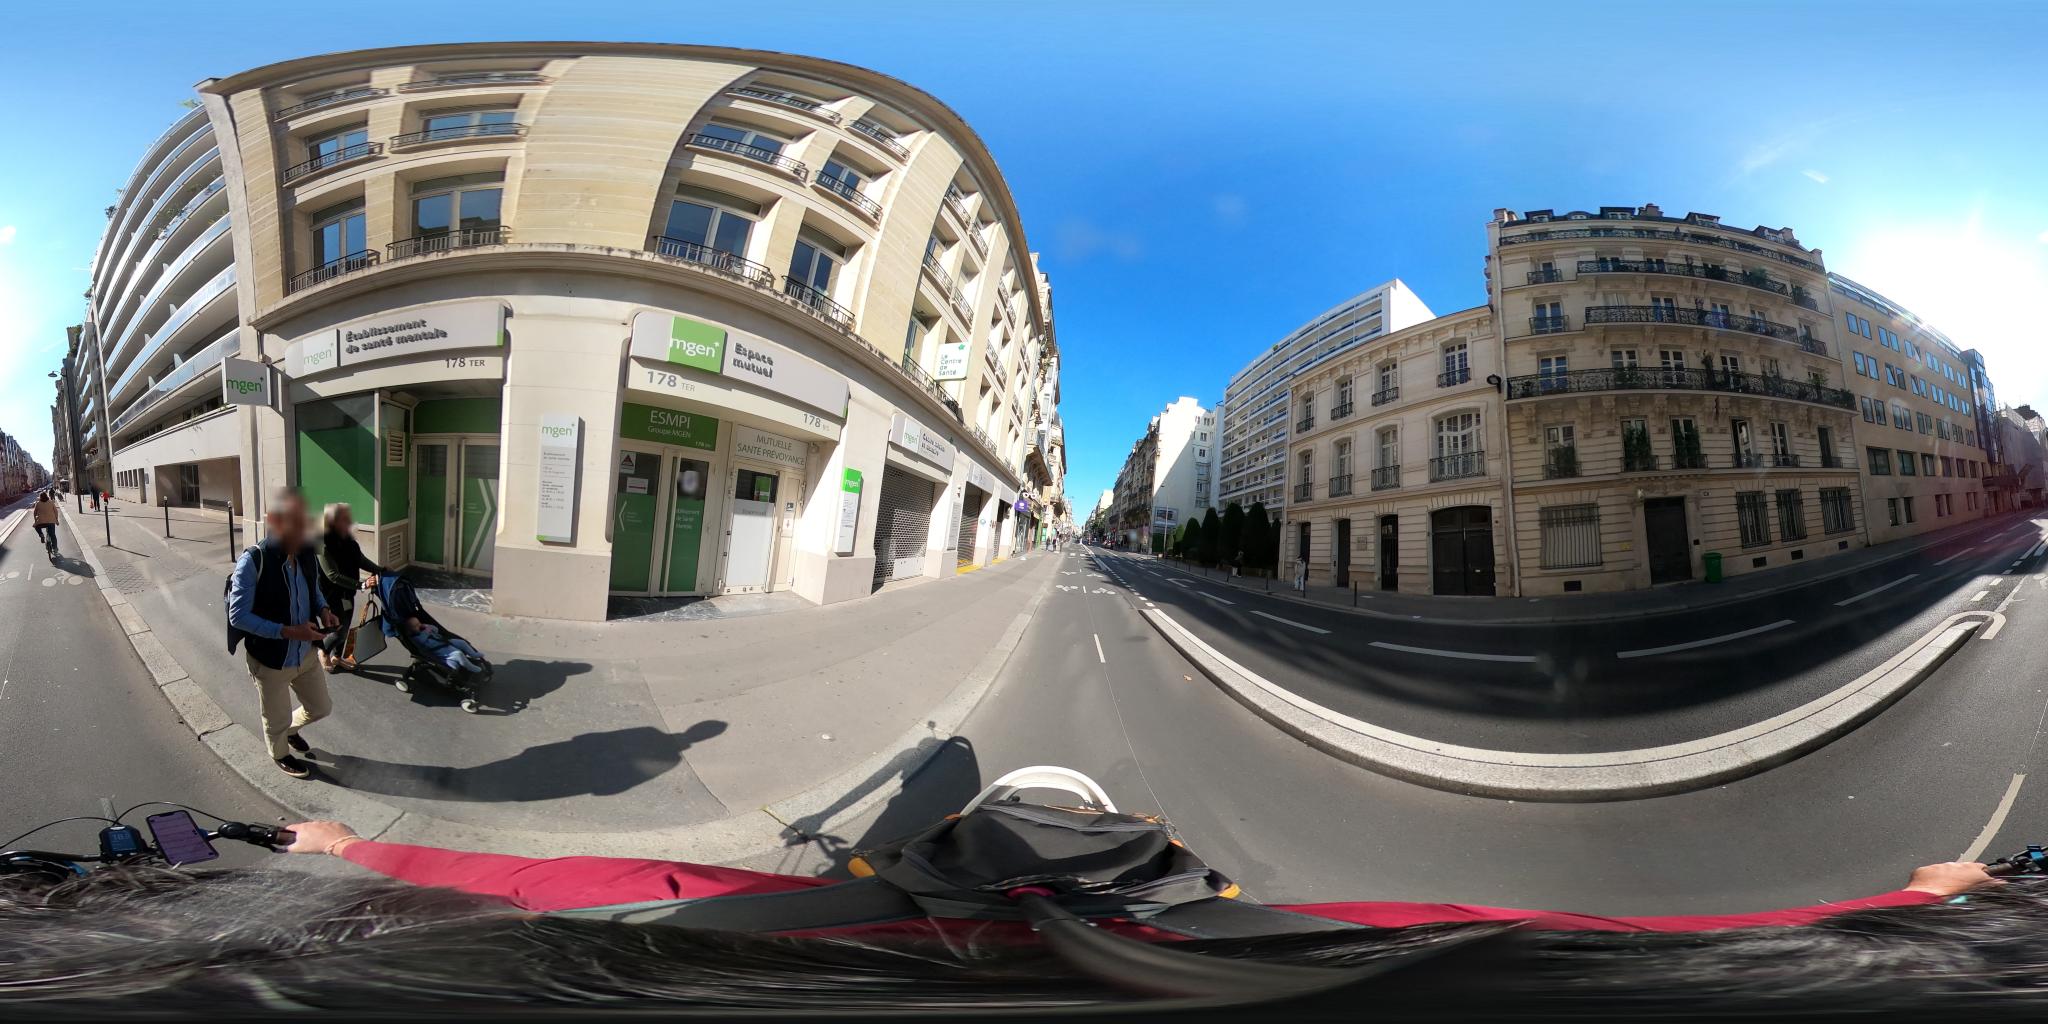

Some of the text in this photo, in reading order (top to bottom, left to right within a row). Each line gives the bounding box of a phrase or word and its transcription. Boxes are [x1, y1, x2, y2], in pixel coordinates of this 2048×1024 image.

[346, 319, 428, 343] Établissement
[346, 328, 448, 354] de santé mentale
[670, 337, 716, 358] mgen
[304, 348, 332, 366] mgen
[734, 342, 774, 366] Espace
[445, 358, 486, 369] 178 TER
[733, 358, 773, 379] mutuel
[227, 379, 262, 394] mgen
[647, 371, 696, 392] 178 TER
[650, 410, 691, 429] ESMPI
[803, 413, 821, 428] 178
[542, 425, 572, 438] mgen
[672, 428, 691, 438] MGEN
[756, 434, 792, 451] MUTUELLE
